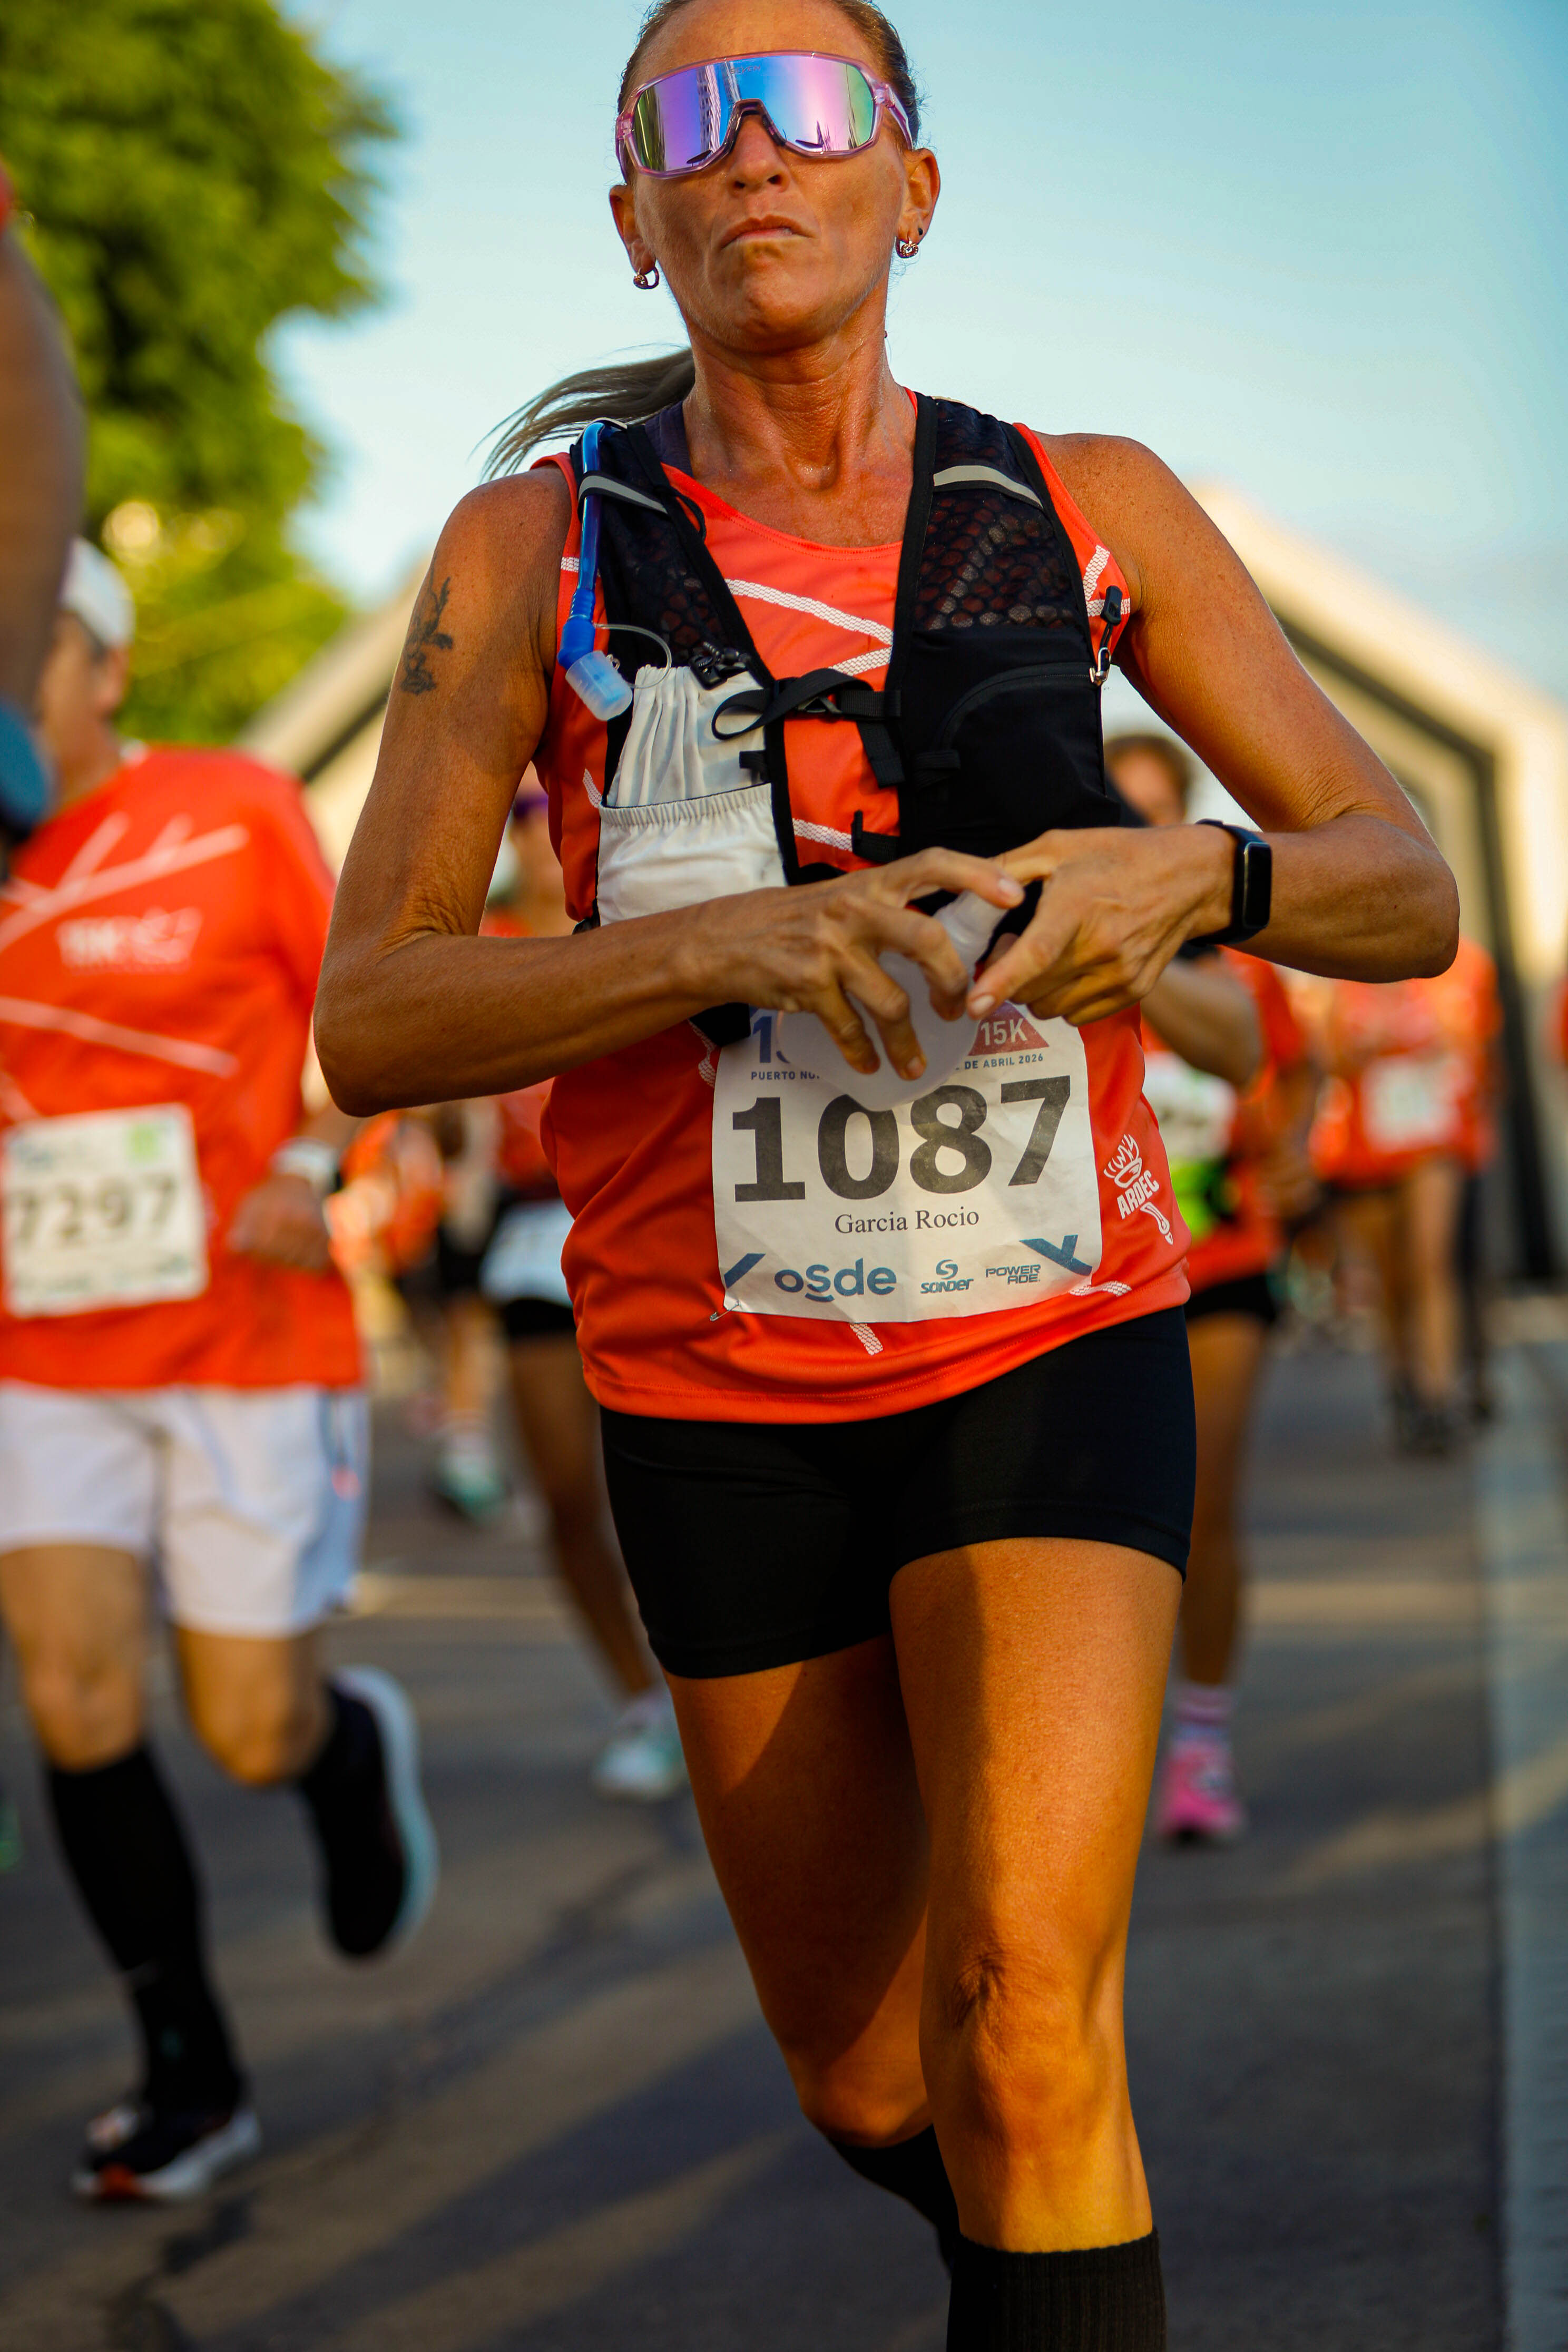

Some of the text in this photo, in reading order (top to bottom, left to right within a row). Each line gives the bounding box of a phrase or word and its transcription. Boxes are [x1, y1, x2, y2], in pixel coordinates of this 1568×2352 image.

[981, 1018, 1027, 1046] 15K
[965, 1053, 1043, 1070] DE ABRIL 2026
[751, 1071, 795, 1080] PUERTO
[732, 1075, 1070, 1202] 1087
[1117, 1170, 1160, 1220] ARDEC
[835, 1206, 979, 1233] Garcia Rocio
[774, 1257, 897, 1302] osde
[986, 1265, 1041, 1278] POWER
